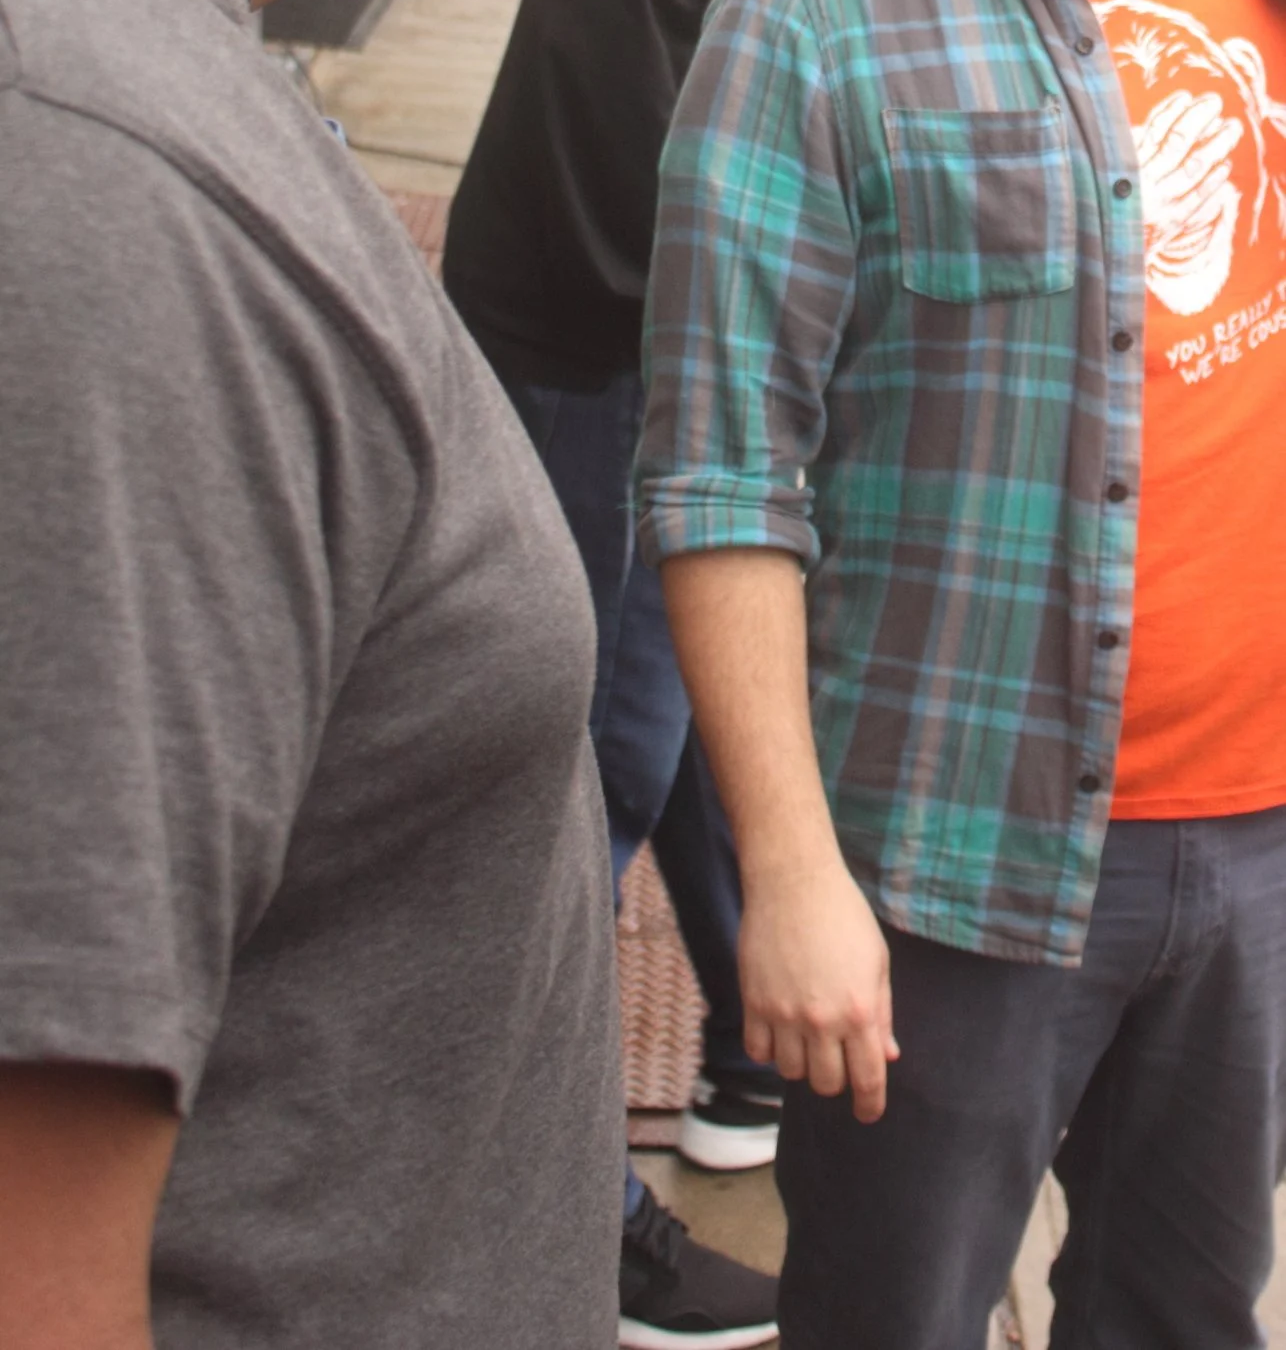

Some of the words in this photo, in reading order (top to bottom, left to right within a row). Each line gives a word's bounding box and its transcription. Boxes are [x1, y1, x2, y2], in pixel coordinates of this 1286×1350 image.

[1165, 333, 1207, 370] YOU
[1212, 290, 1273, 342] REALLY
[1178, 335, 1243, 385] WE'RE
